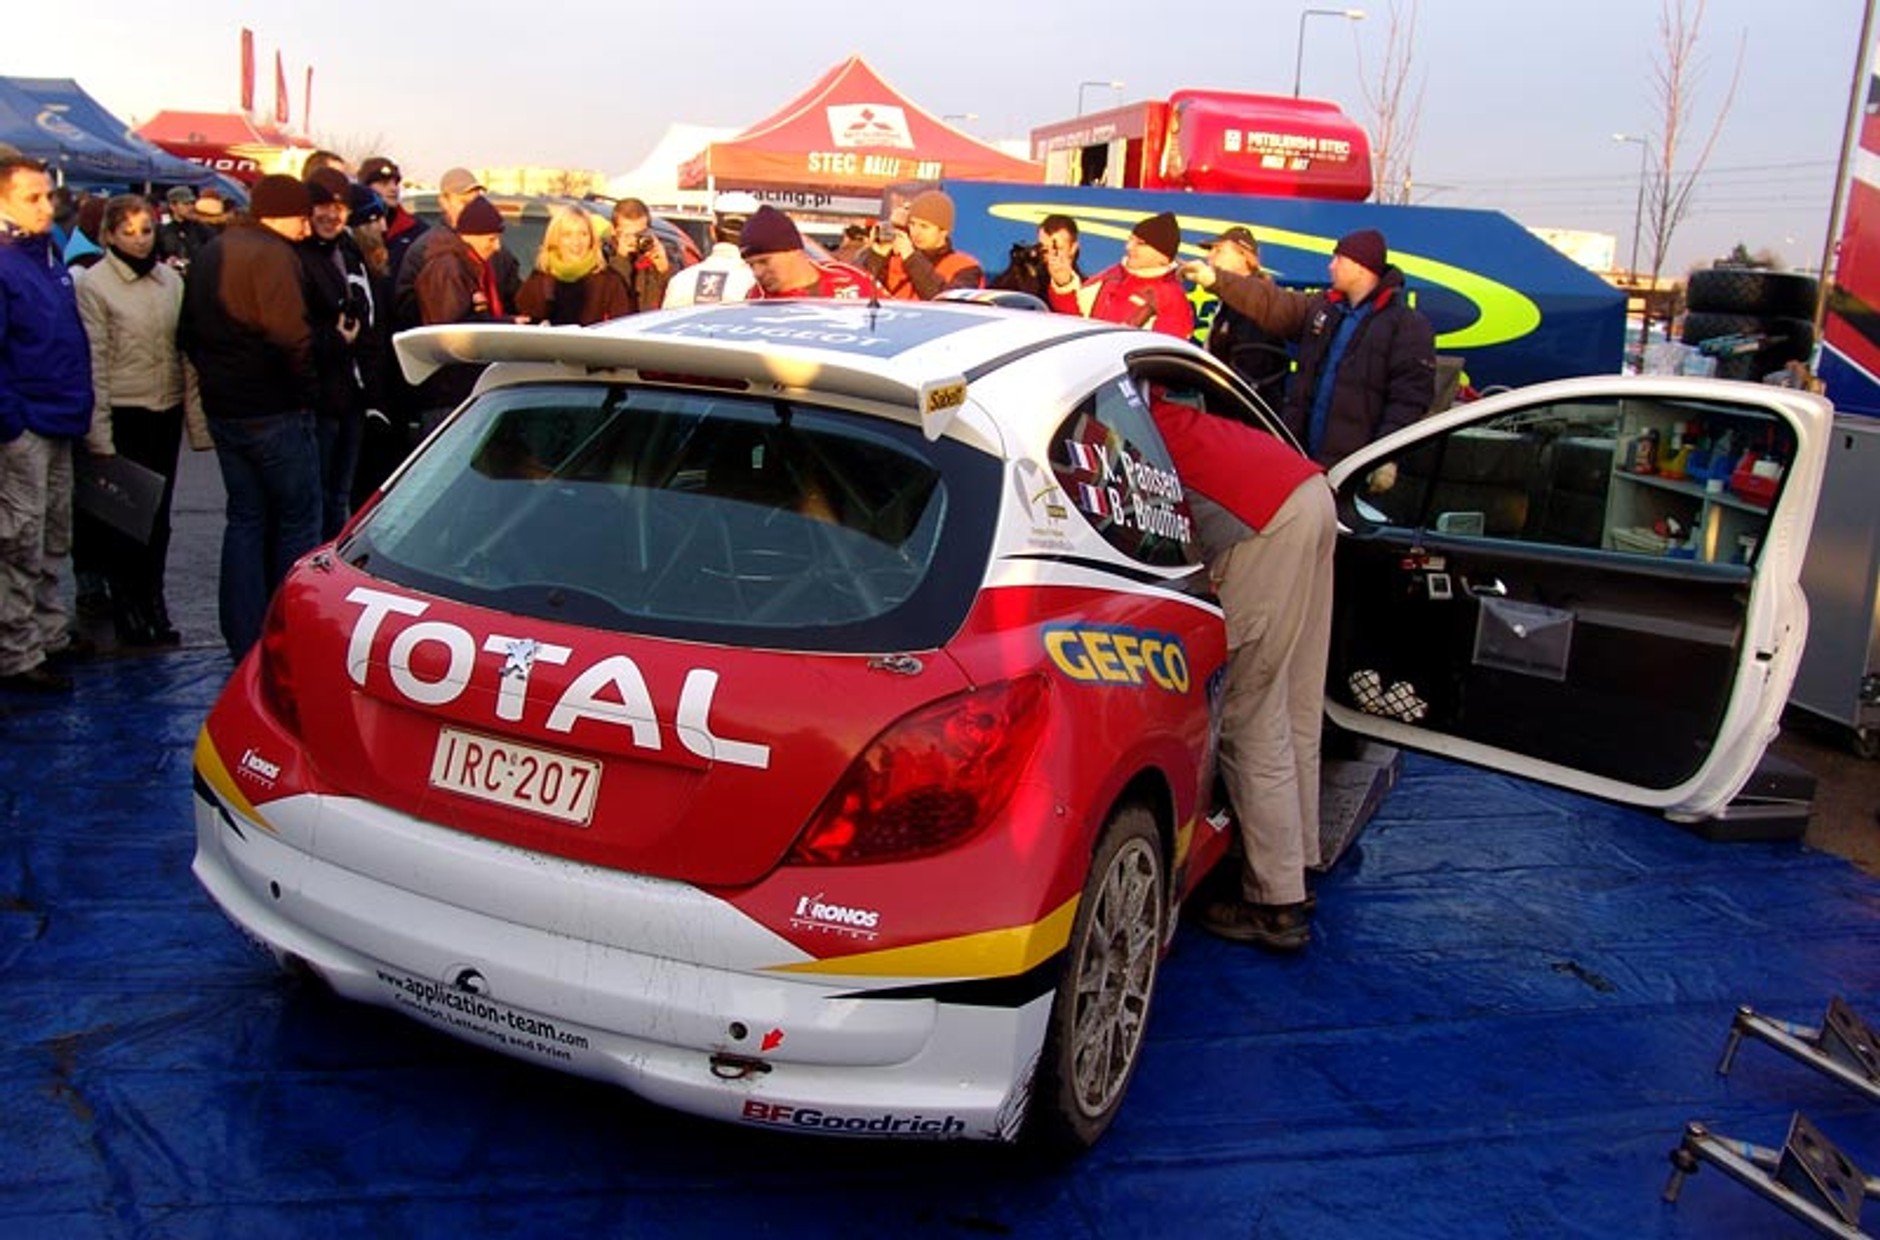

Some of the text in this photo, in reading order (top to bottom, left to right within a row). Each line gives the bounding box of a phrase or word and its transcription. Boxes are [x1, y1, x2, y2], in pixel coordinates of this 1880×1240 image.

[808, 151, 857, 175] STEC
[1107, 486, 1132, 528] B.
[345, 586, 770, 769] TOTAL
[1044, 630, 1191, 694] GEFCO
[241, 747, 281, 780] KRONOS
[796, 892, 880, 928] KRONOS
[741, 1099, 966, 1134] BFGoodrich
